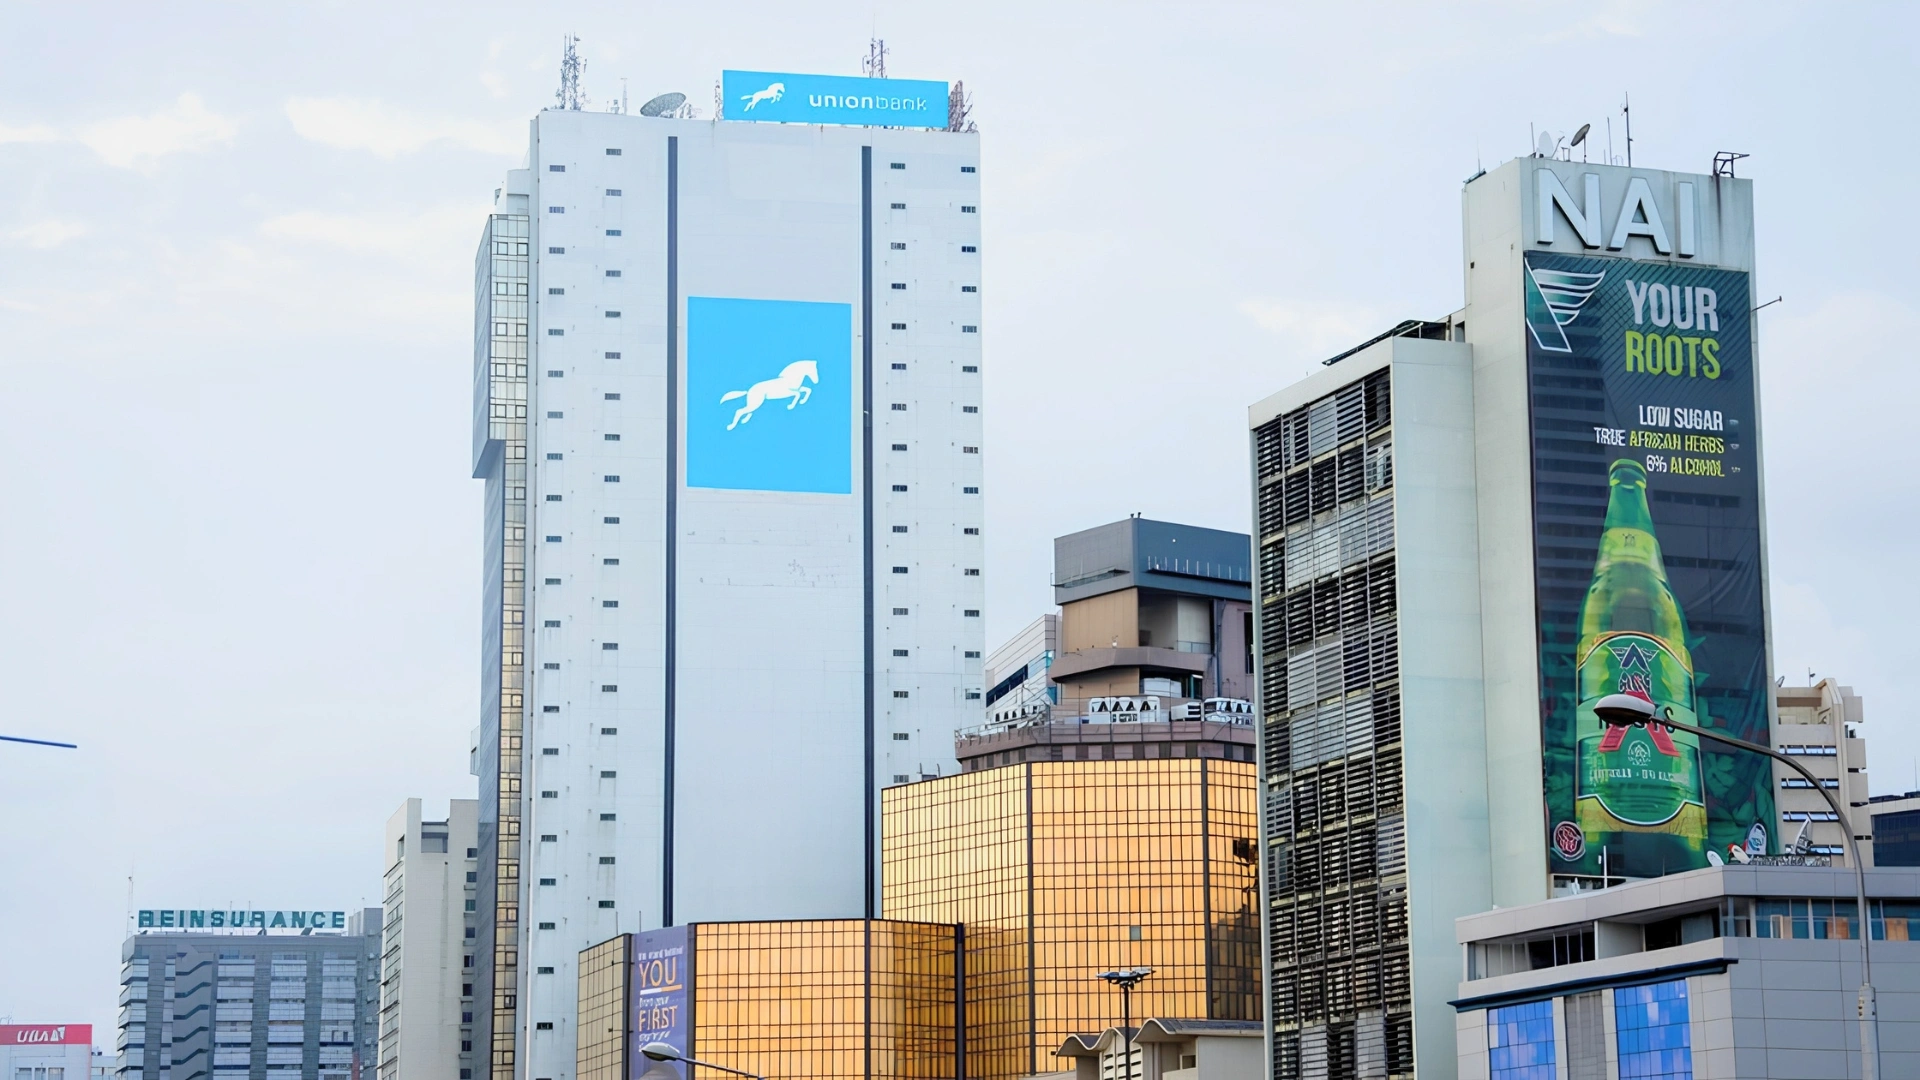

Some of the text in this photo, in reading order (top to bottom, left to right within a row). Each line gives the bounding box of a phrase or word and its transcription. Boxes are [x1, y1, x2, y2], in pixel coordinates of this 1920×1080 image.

[809, 94, 927, 111] unionbank
[1534, 168, 1695, 258] NAI
[1625, 279, 1720, 332] YOUR
[1625, 330, 1721, 380] ROOTS
[1639, 405, 1724, 431] LOW SUGAR
[1593, 427, 1725, 454] TRUE AFRICAN HERBS
[1646, 454, 1725, 477] 6% ALCOHOL
[138, 910, 345, 928] REINSURANCE
[639, 956, 677, 988] YOU
[639, 1005, 678, 1032] FIRST
